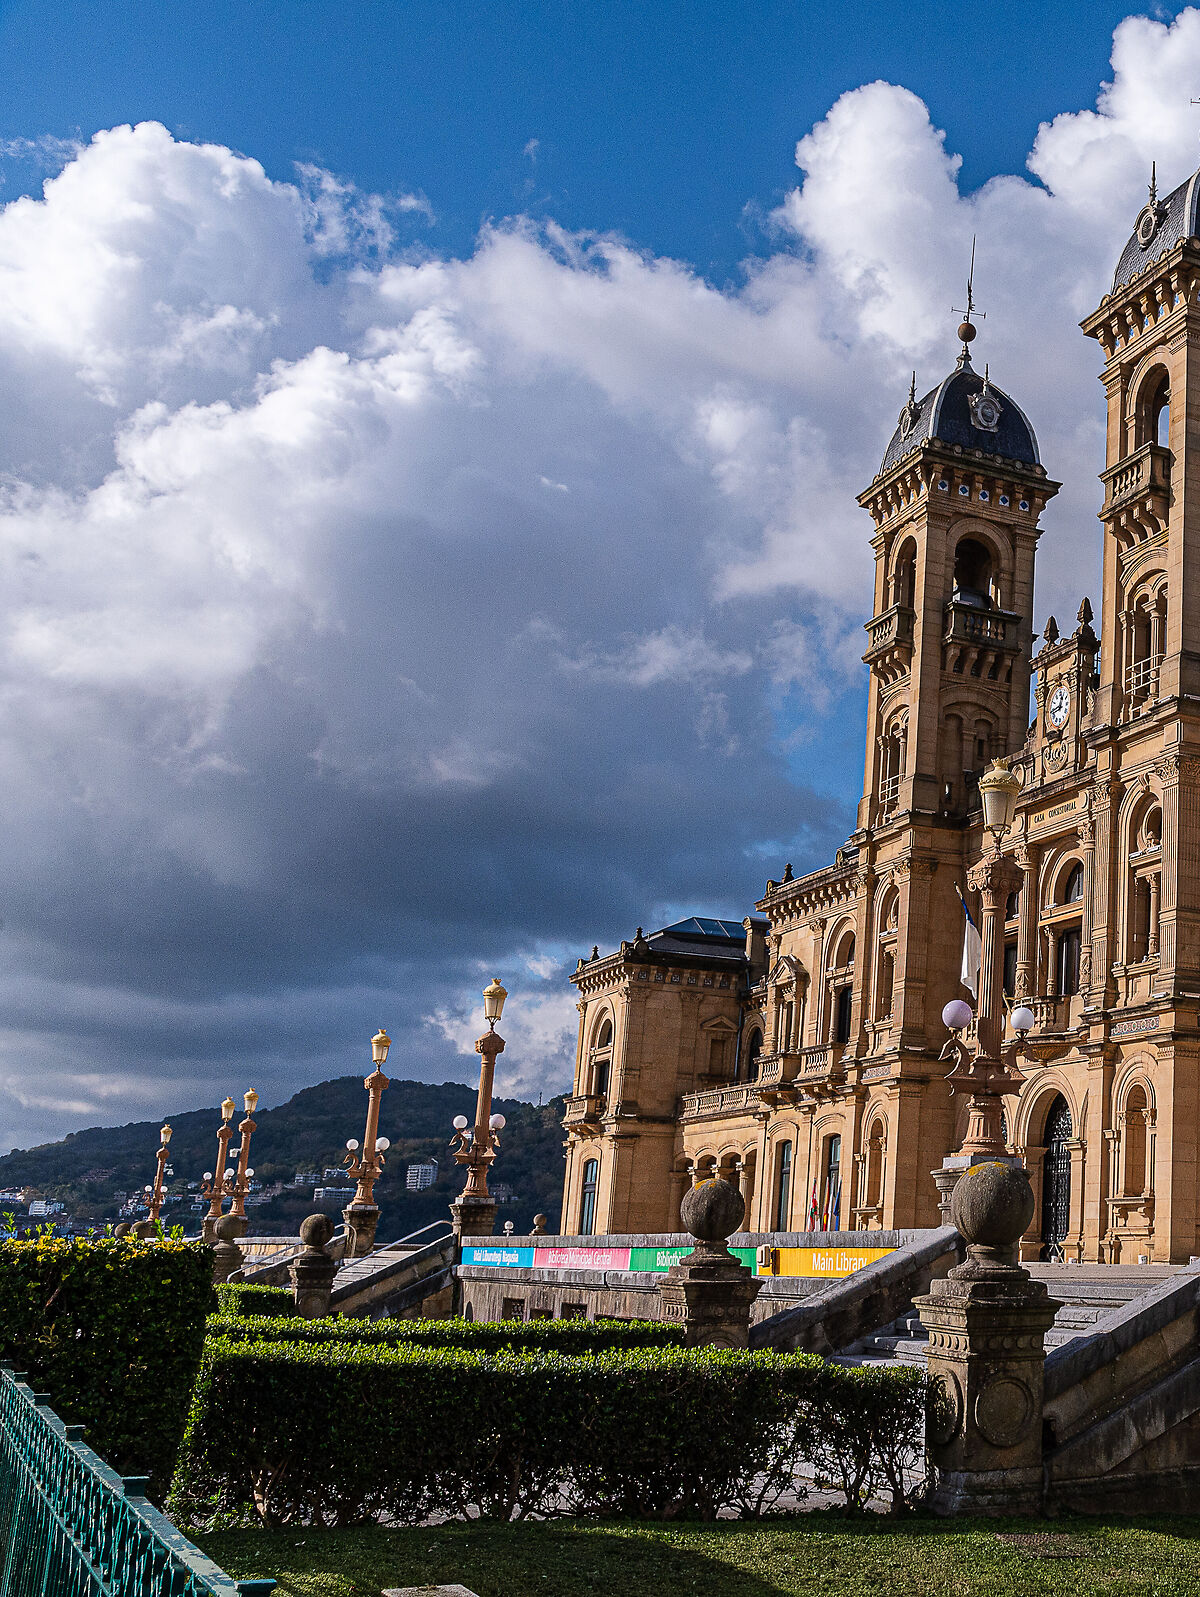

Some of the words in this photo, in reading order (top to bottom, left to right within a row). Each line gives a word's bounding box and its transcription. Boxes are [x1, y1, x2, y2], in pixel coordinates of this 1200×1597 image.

[548, 1250, 569, 1264] Biblioteca
[569, 1250, 593, 1266] Municipal
[593, 1250, 612, 1265] Central
[812, 1252, 834, 1271] Main
